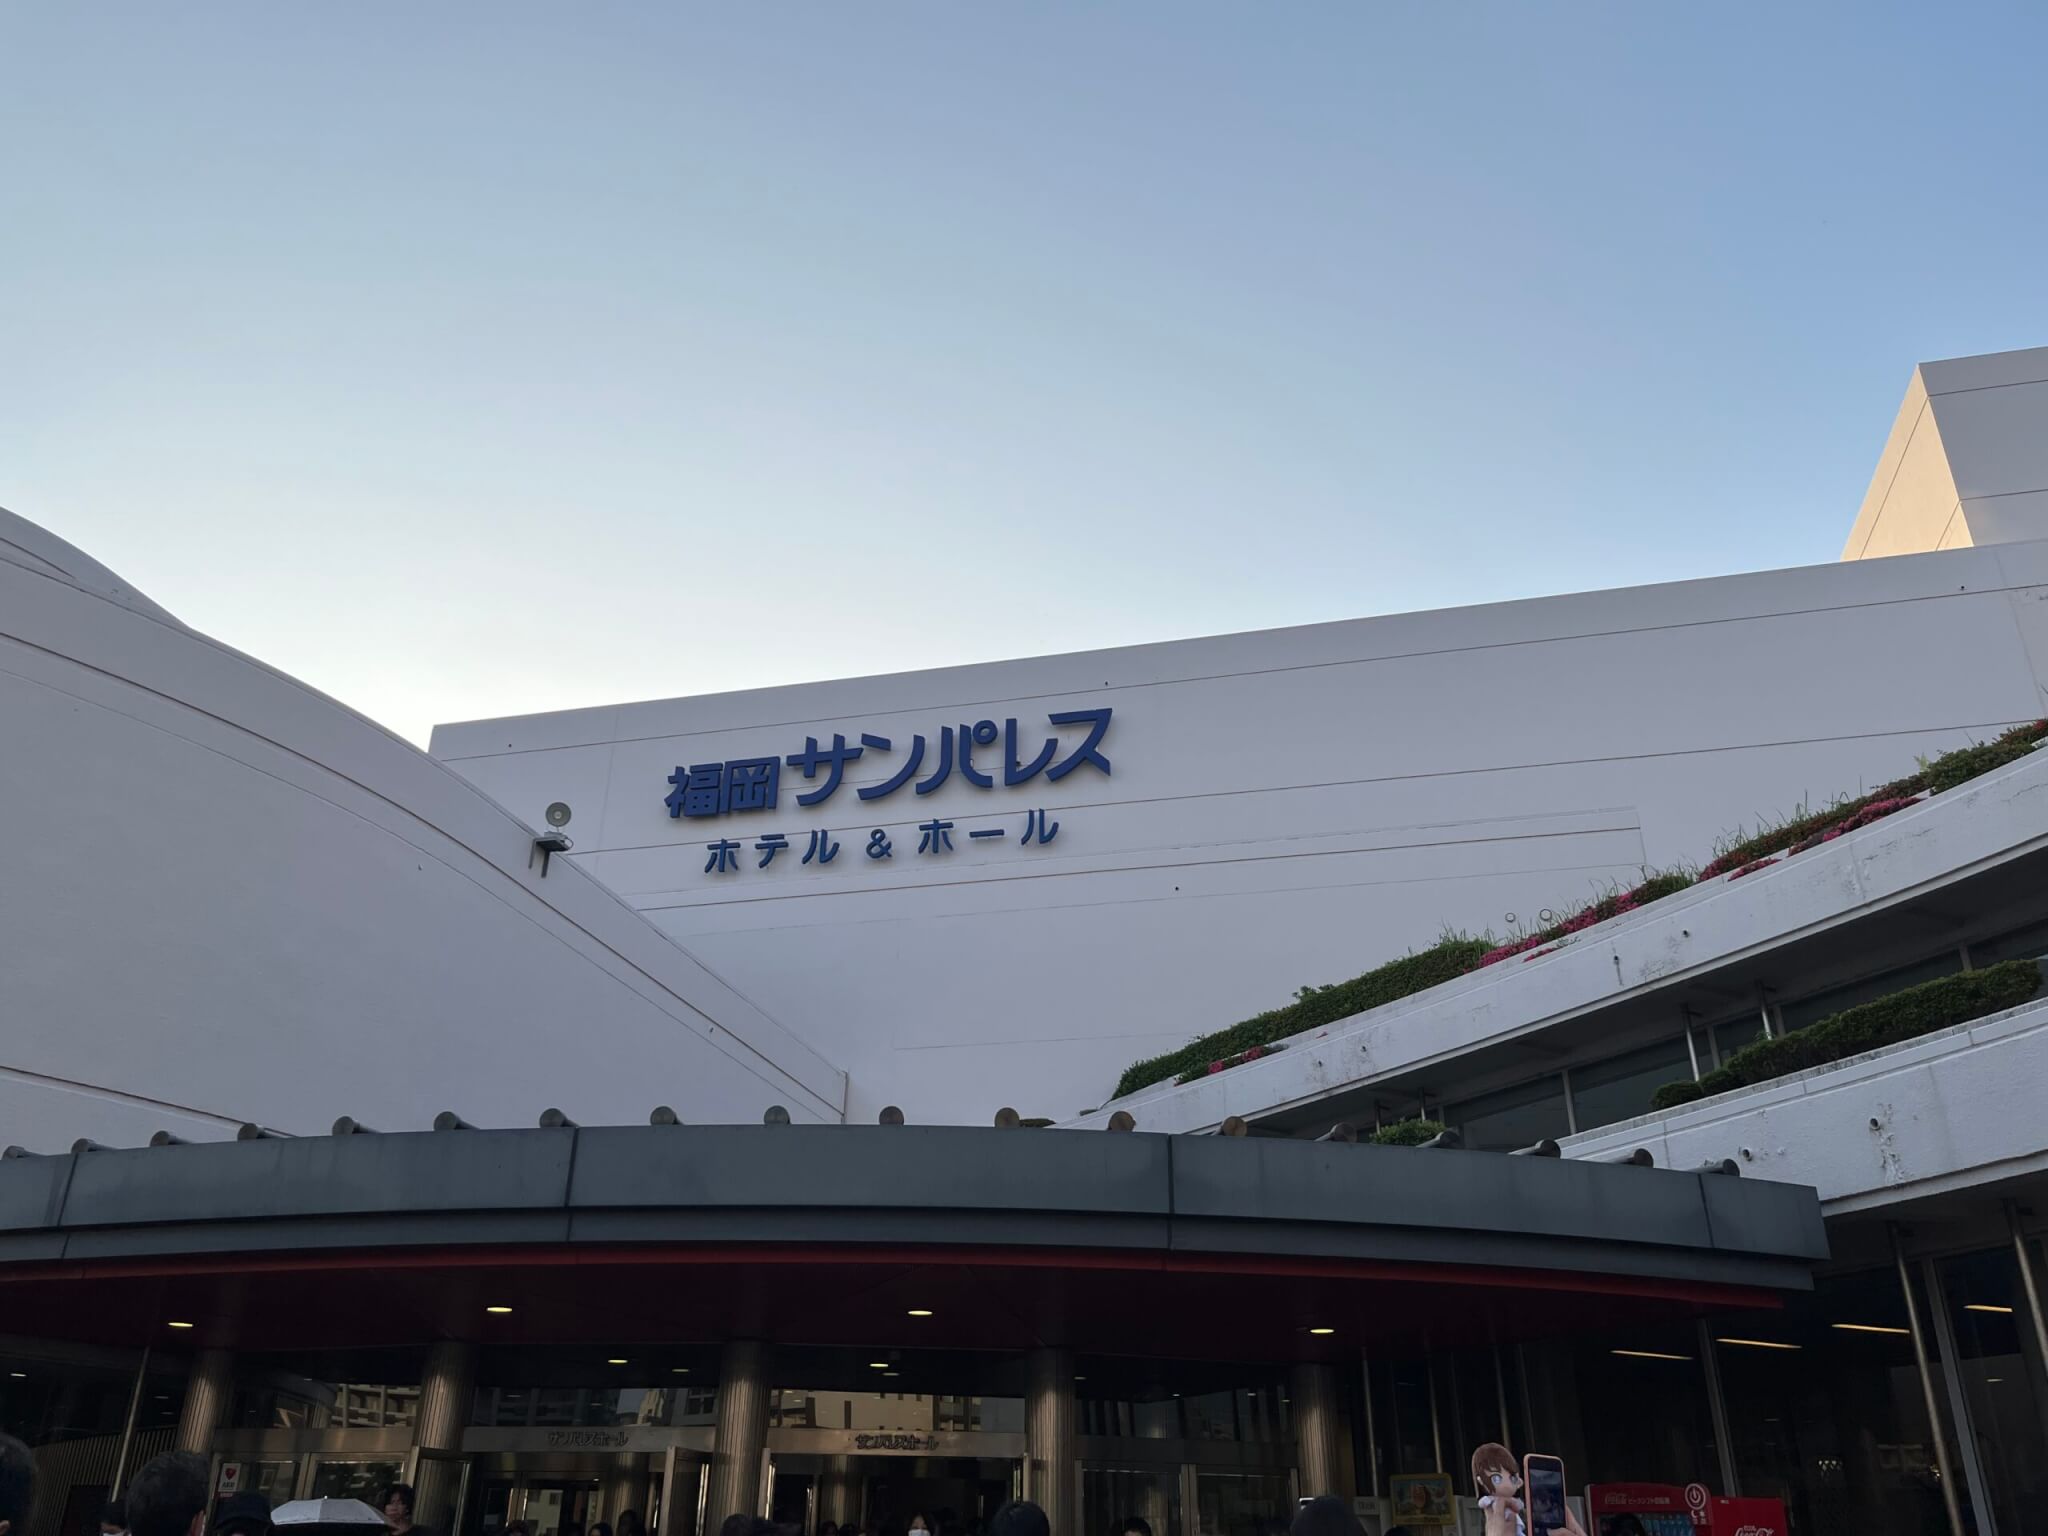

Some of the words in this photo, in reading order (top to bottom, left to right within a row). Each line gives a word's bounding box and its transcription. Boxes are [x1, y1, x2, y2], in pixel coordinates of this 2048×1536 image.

[664, 708, 1112, 818] 福岡サンパレス
